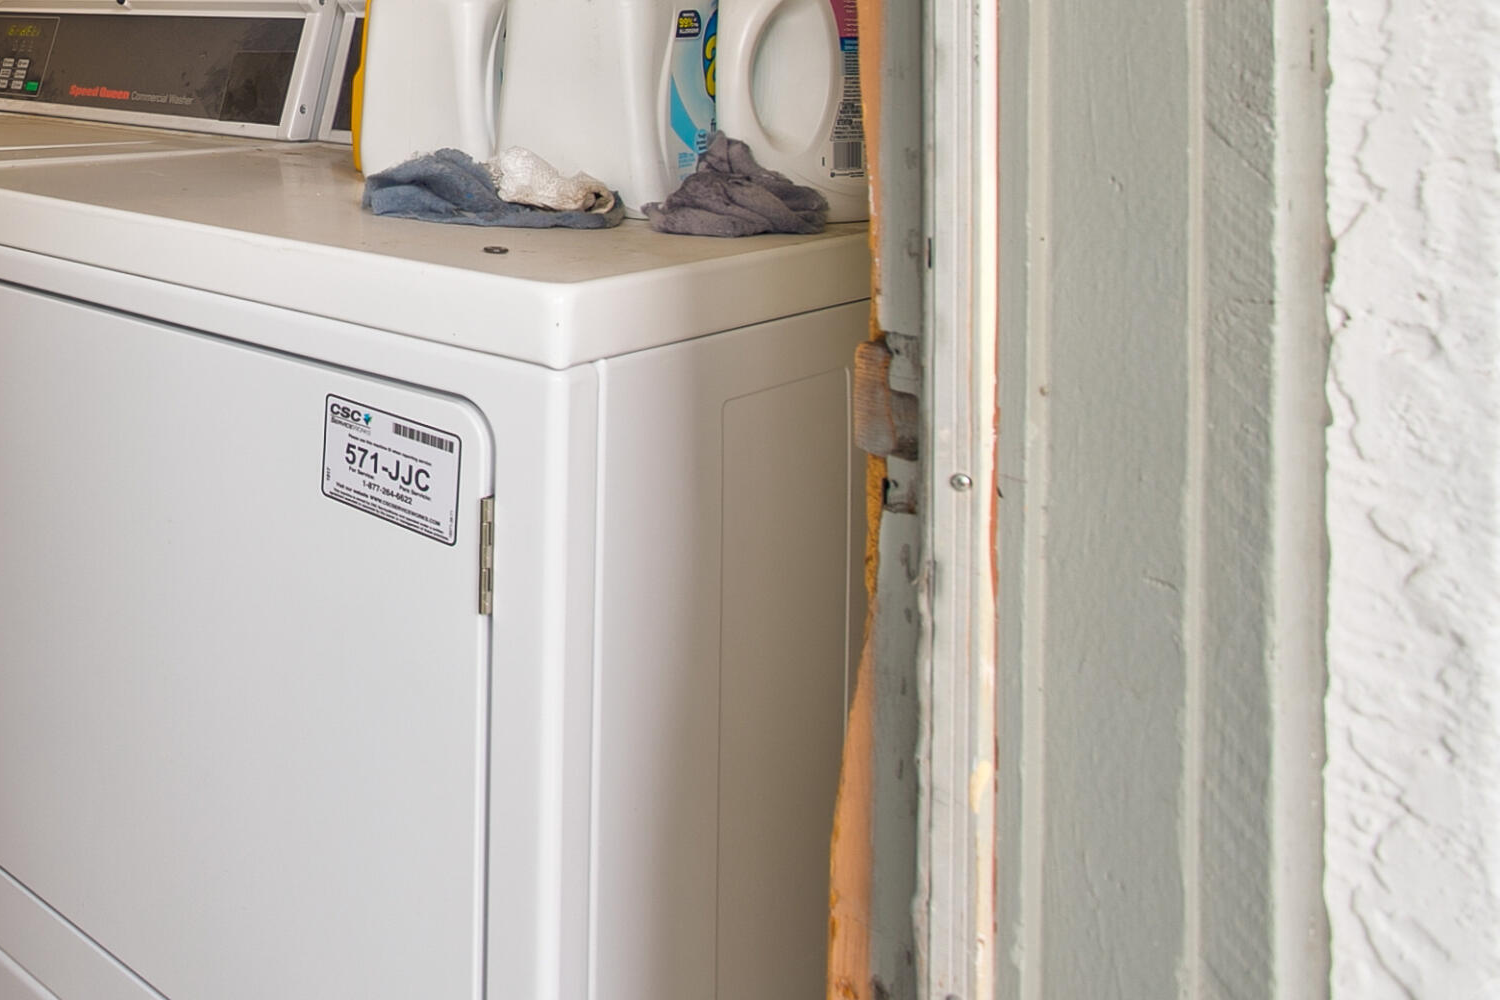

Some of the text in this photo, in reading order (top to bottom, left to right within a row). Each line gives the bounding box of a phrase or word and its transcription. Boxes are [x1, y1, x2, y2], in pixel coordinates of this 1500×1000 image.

[68, 85, 99, 99] Speed
[99, 86, 130, 100] Queen
[330, 403, 362, 422] CSC
[344, 442, 431, 493] 571-JJC
